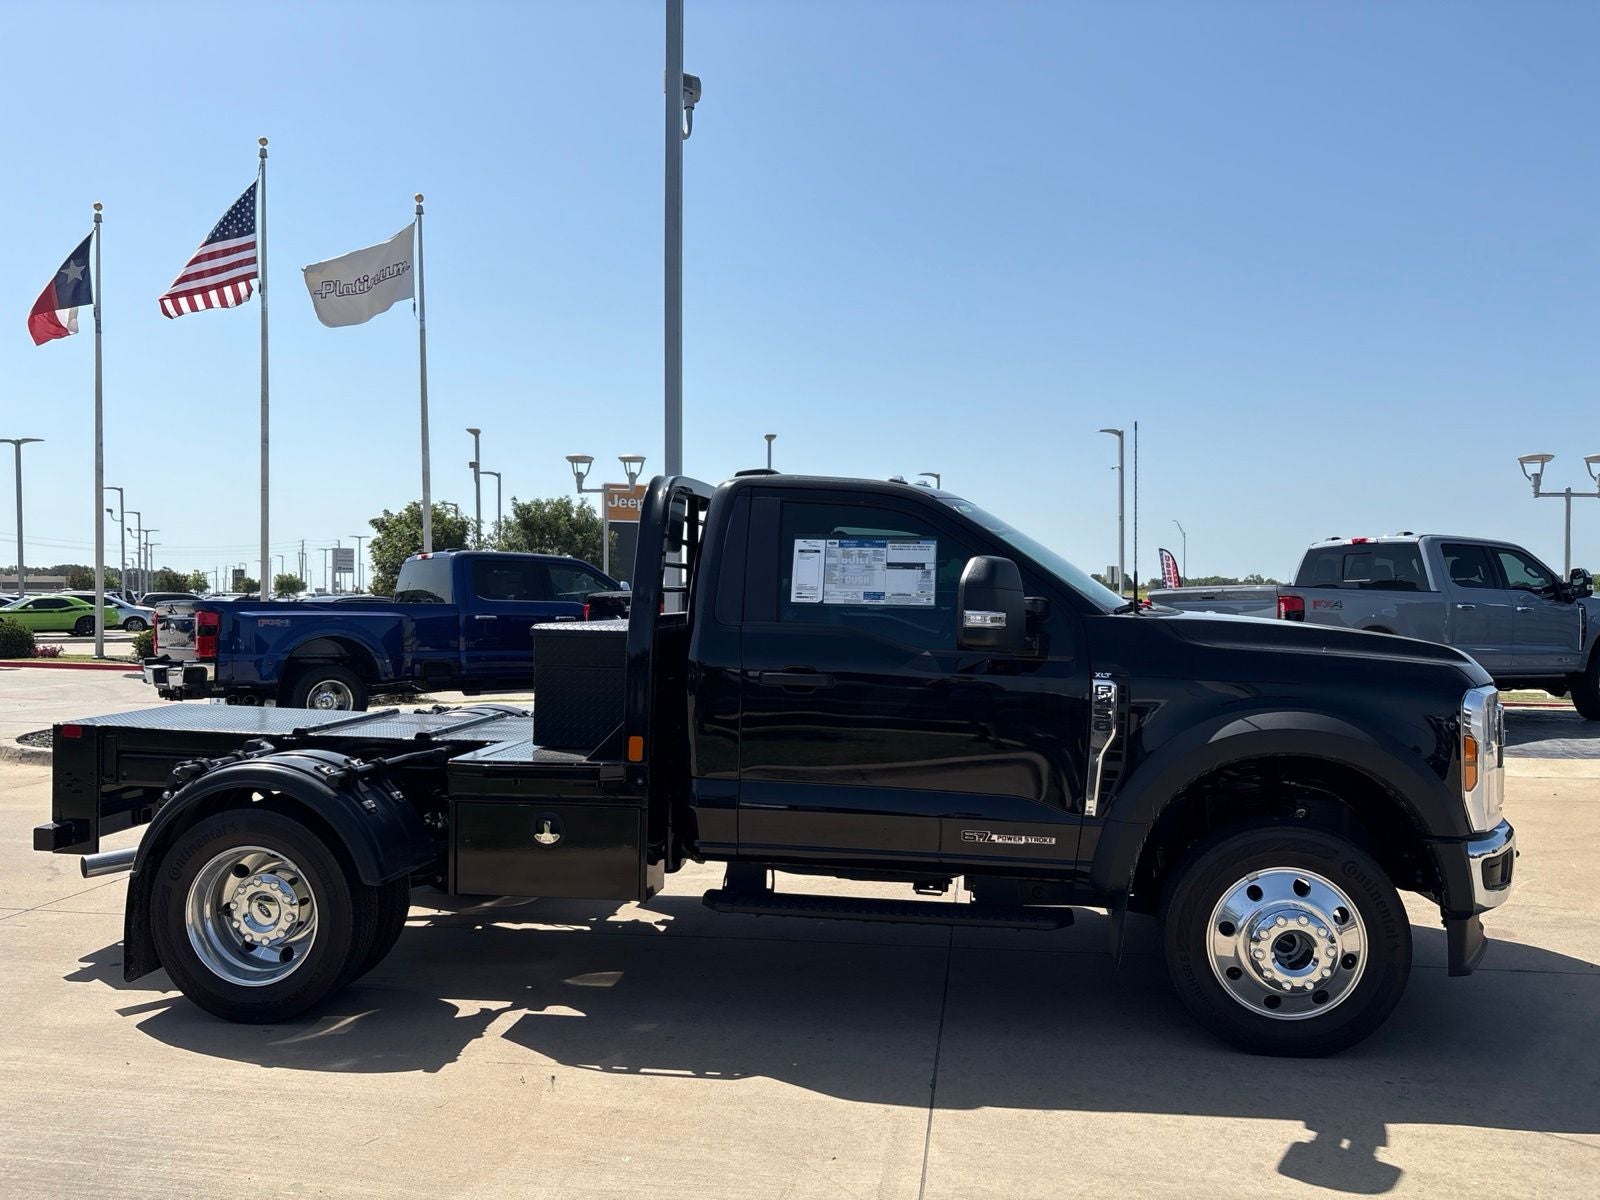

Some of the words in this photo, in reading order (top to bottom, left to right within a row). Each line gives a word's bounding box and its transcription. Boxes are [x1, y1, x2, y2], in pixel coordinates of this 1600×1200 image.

[314, 261, 410, 299] Platinum
[1094, 671, 1112, 679] XLT
[168, 824, 228, 882] Continental
[997, 835, 1023, 843] POWER
[1024, 836, 1055, 845] STROKE
[1341, 860, 1399, 938] Continental
